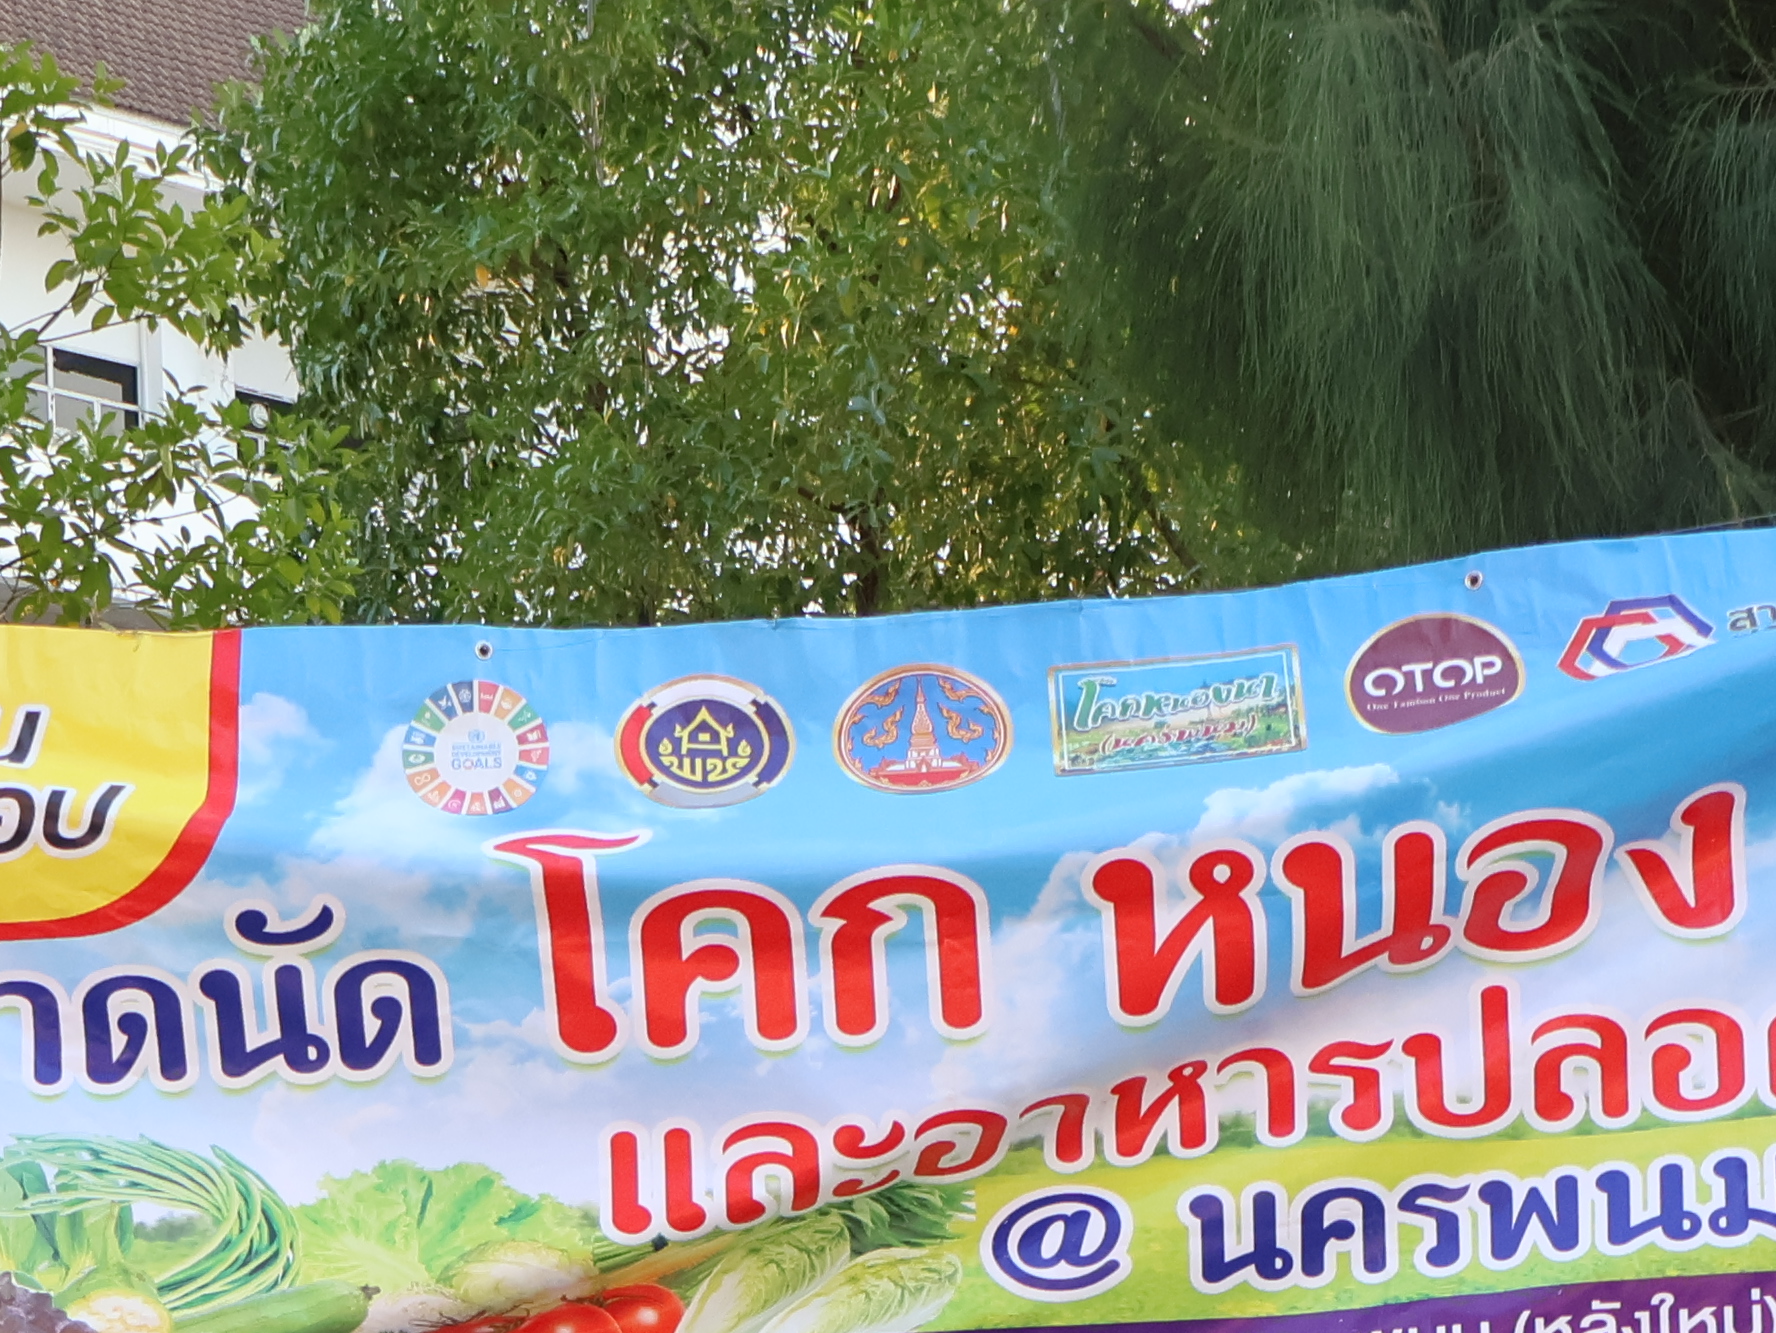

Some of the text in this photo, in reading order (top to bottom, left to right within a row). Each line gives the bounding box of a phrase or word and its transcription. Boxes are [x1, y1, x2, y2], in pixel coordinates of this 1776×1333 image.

[1363, 656, 1503, 697] OTOP
[452, 757, 503, 770] GOALS
[492, 833, 981, 1055] โคก
[1092, 783, 1743, 1018] หนอง
[995, 1192, 1125, 1287] @
